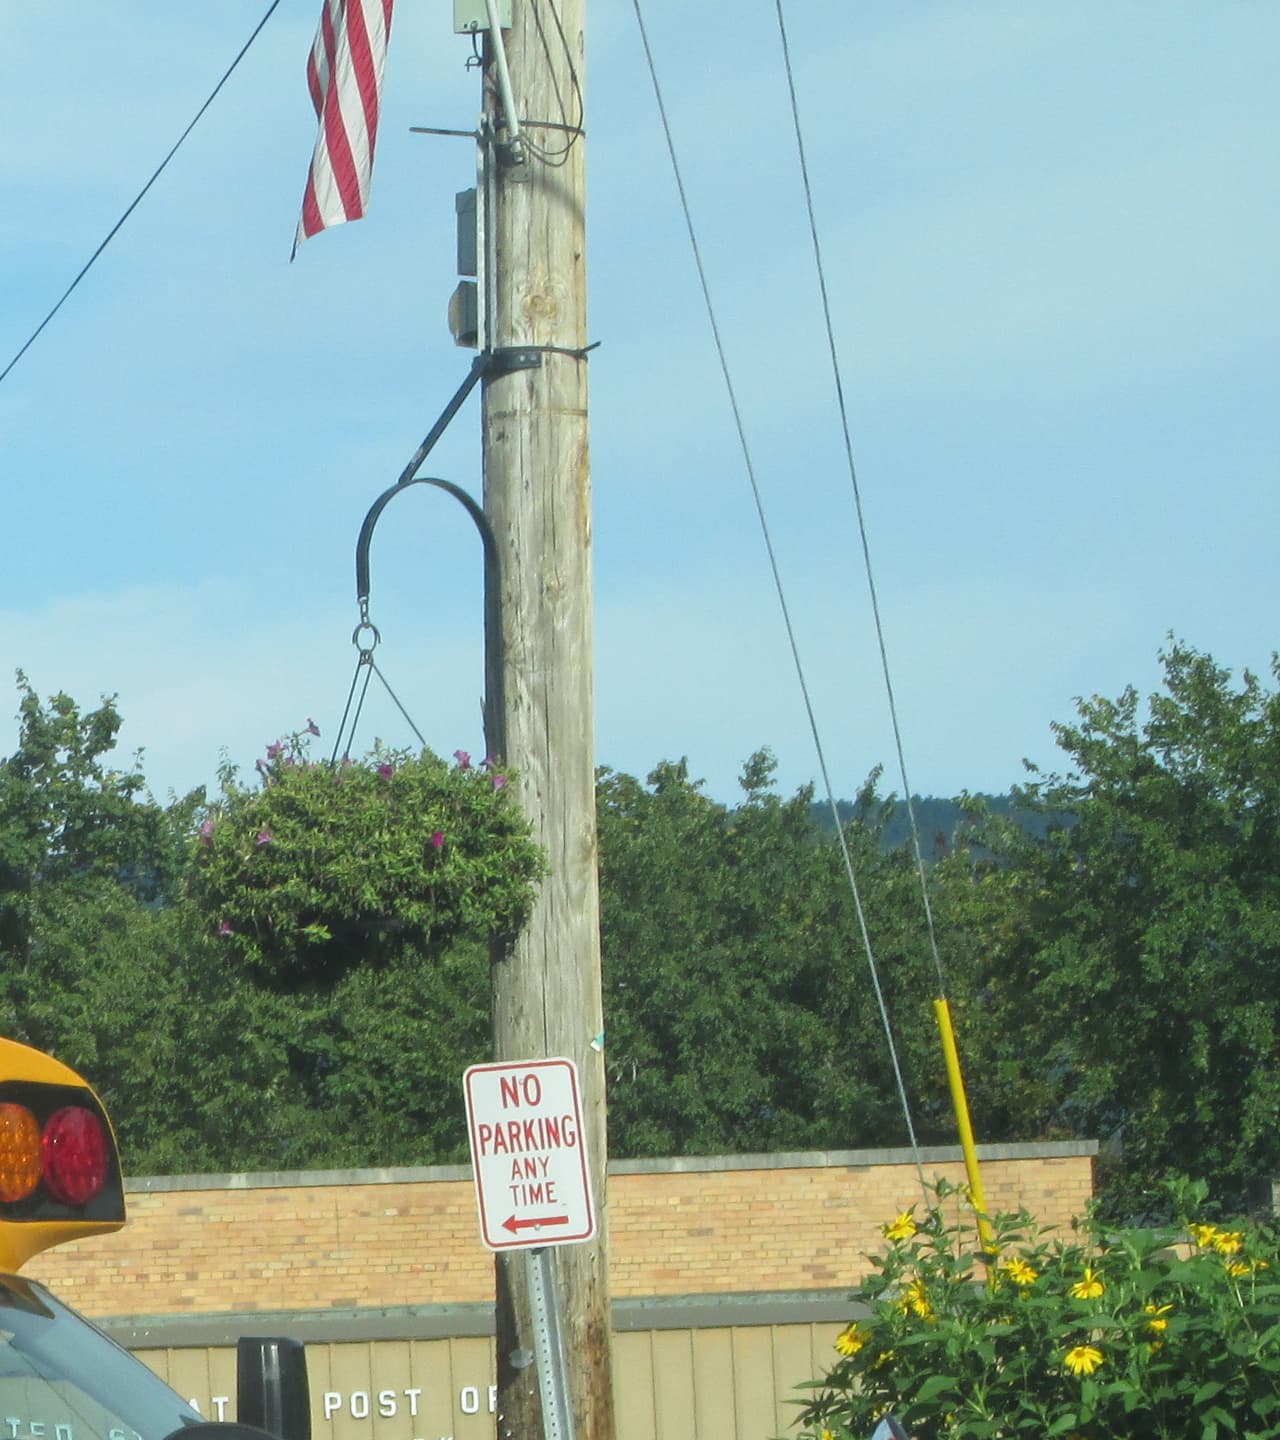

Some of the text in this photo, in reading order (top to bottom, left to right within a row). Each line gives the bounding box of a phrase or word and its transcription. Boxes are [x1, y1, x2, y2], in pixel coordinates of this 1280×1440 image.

[500, 1073, 541, 1109] NO
[478, 1115, 576, 1156] PARKING
[511, 1156, 549, 1181] ANY
[509, 1182, 558, 1207] TIME
[324, 1389, 421, 1420] POST
